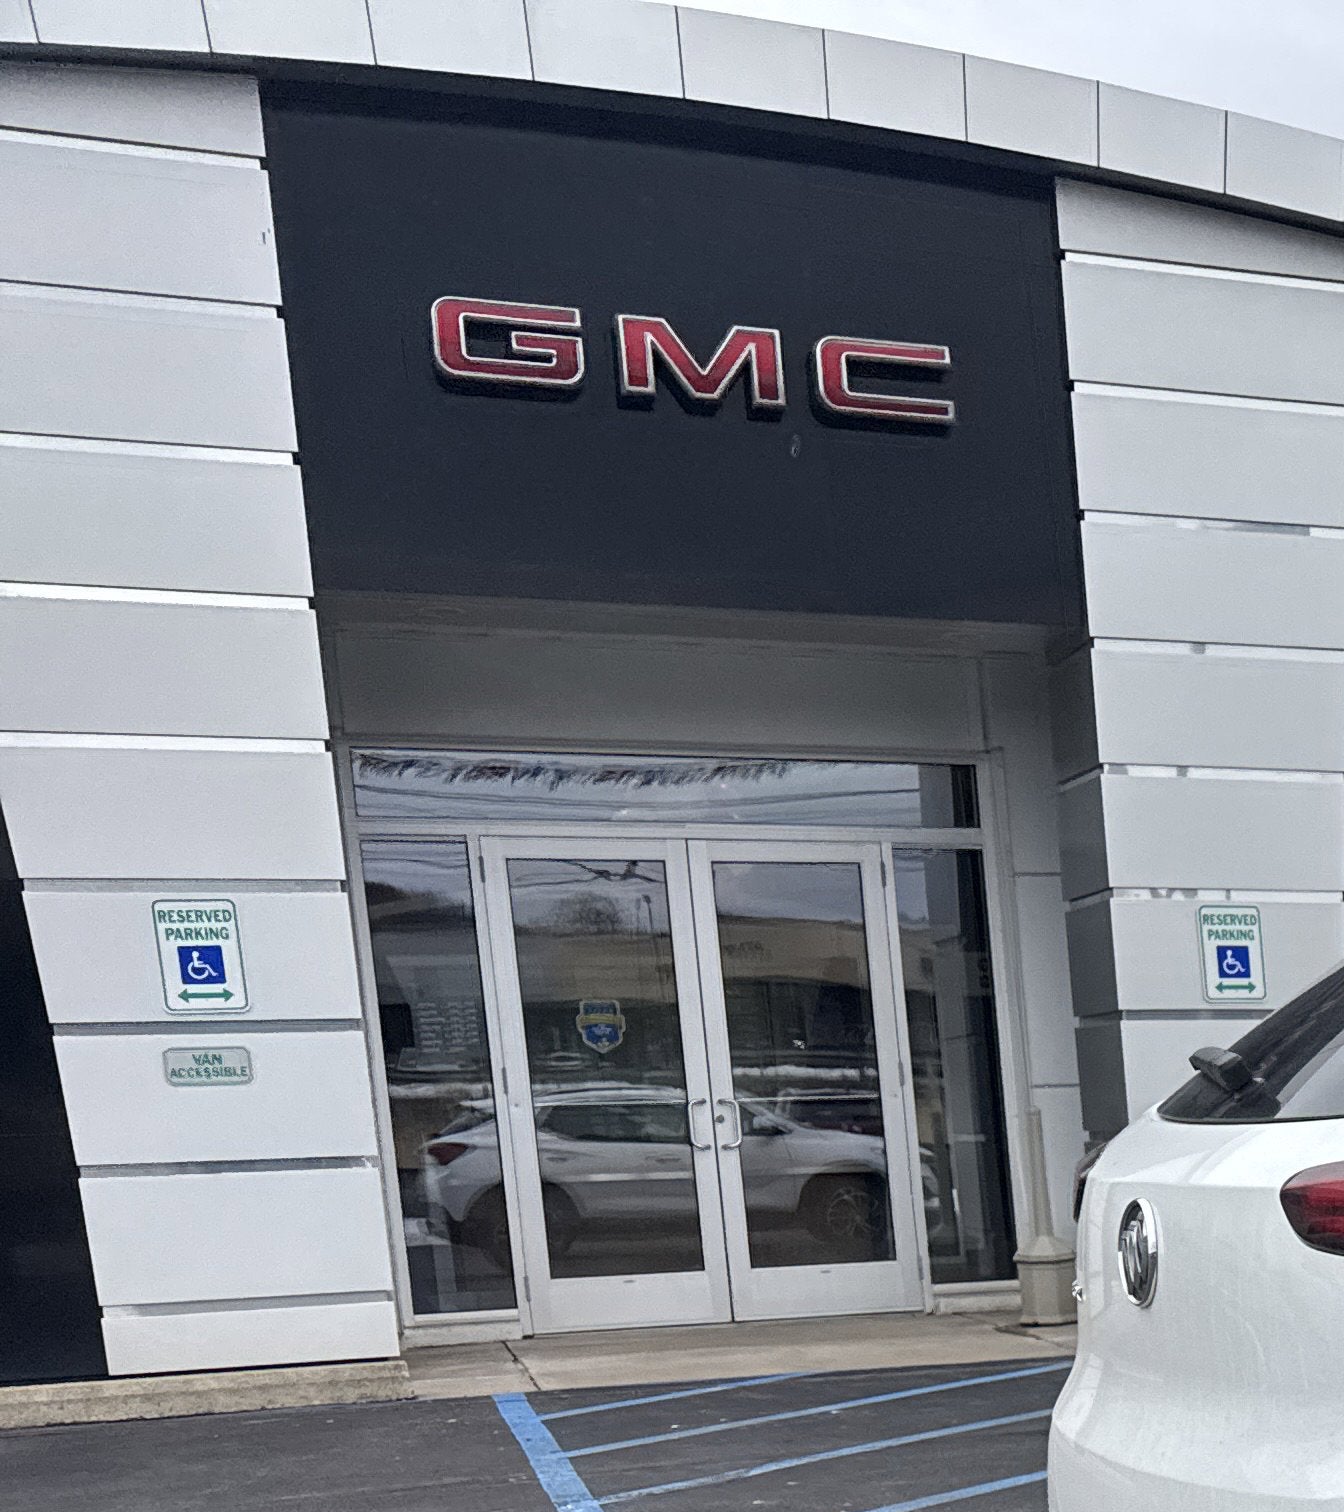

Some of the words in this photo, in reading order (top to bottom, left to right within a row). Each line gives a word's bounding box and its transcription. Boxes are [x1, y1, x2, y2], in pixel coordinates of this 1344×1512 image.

[430, 295, 956, 425] GMC
[157, 909, 232, 923] RESERVED
[1202, 913, 1257, 926] RESERVED
[164, 926, 230, 941] PARKING
[1207, 929, 1255, 941] PARKING
[191, 1053, 223, 1066] VAN
[169, 1066, 248, 1079] ACCESSIBLE
